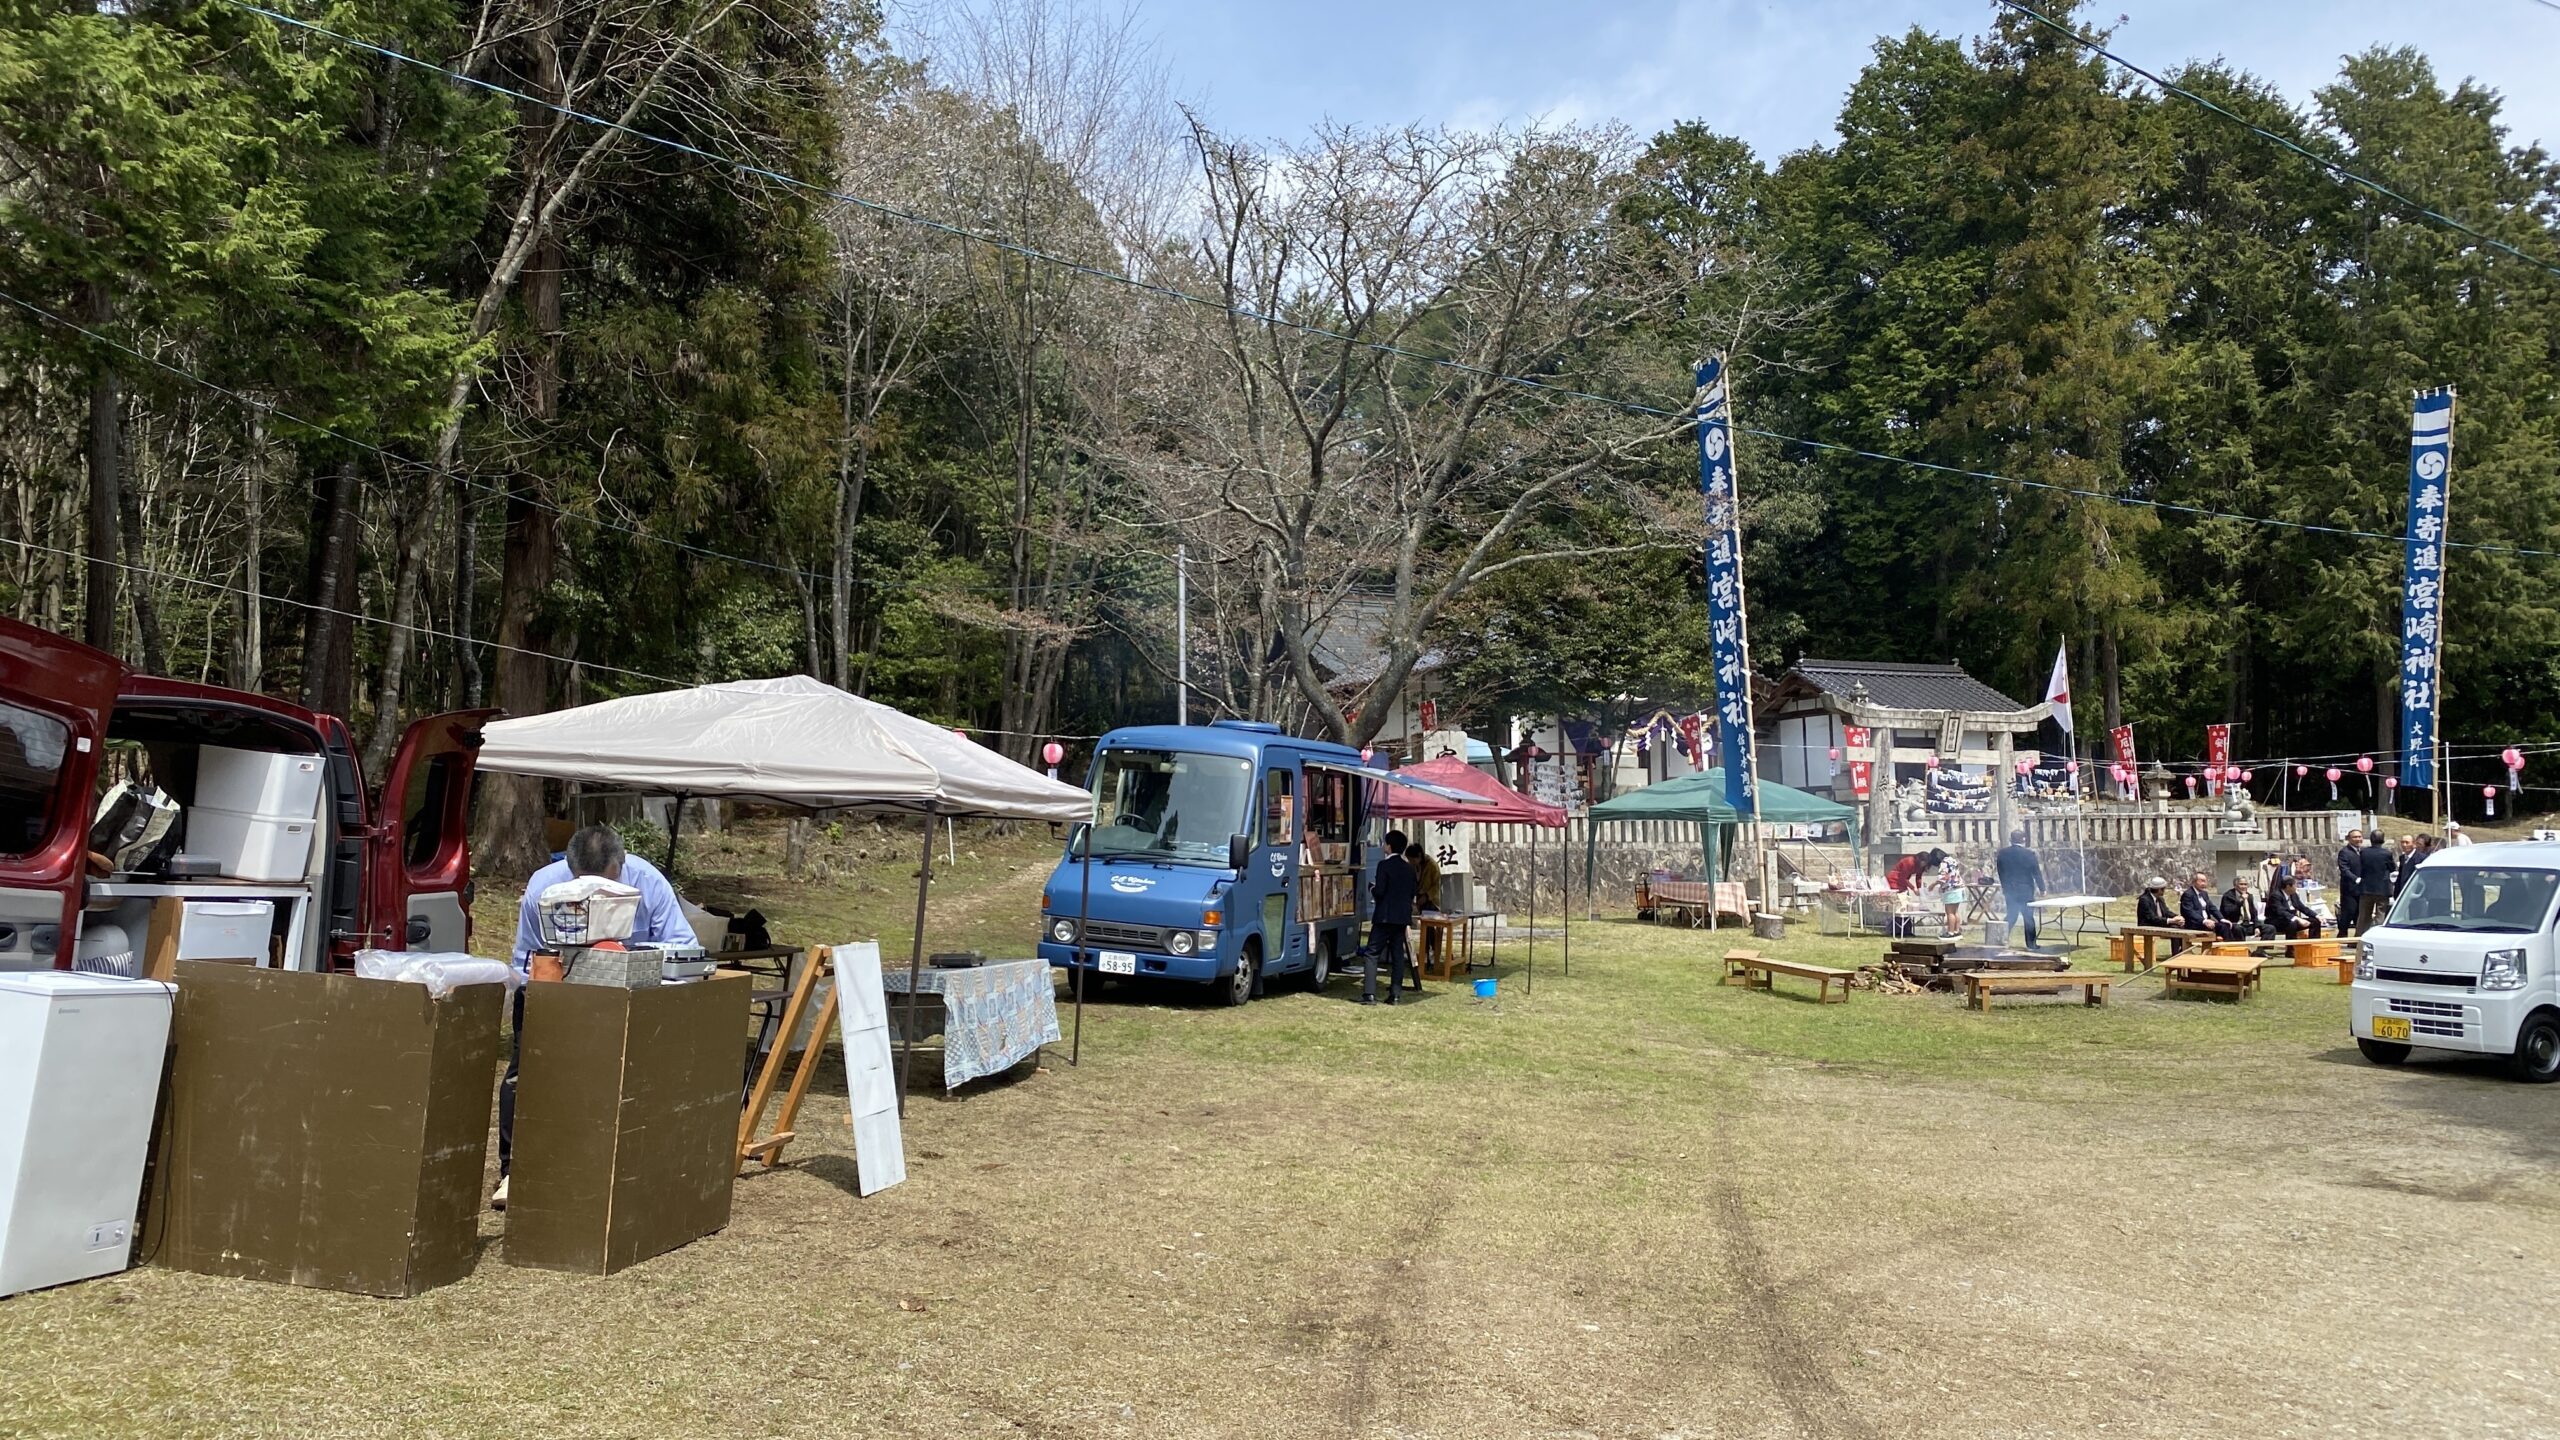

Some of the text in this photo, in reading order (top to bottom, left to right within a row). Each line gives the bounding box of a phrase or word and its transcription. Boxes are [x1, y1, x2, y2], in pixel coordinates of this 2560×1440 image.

[2404, 484, 2443, 711] 奉寄進宮崎神社
[1106, 960, 1133, 973] 58-95
[2381, 1026, 2408, 1038] 60-70
